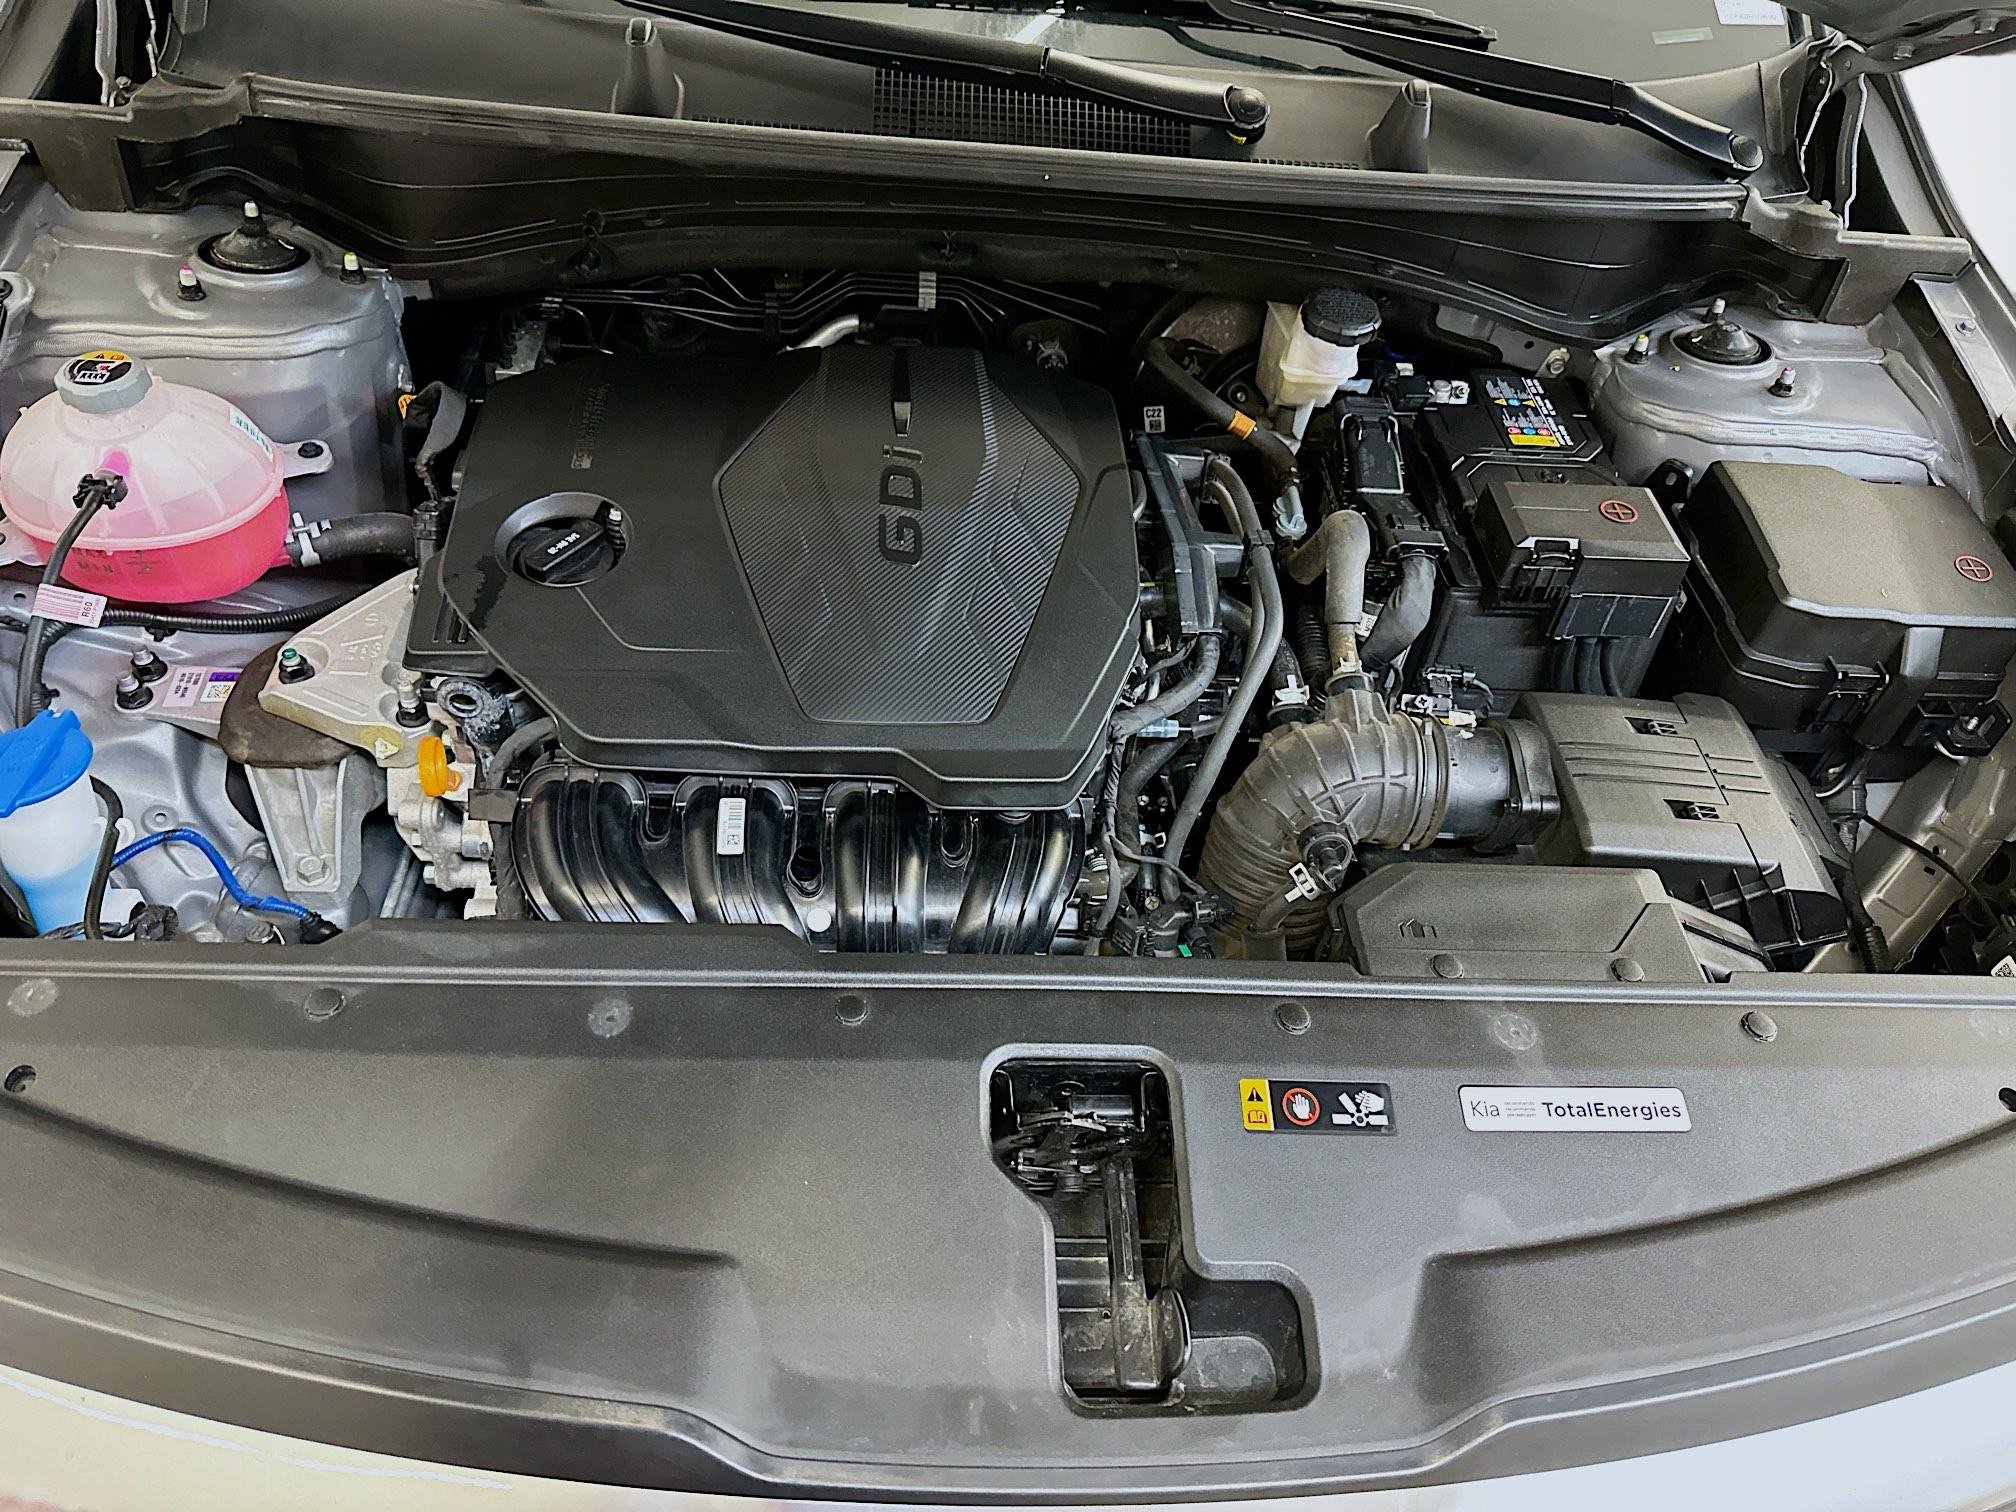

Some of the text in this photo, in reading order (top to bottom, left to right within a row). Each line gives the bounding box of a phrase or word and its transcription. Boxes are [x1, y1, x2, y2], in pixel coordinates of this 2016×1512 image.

[1145, 408, 1162, 418] C22
[879, 444, 923, 567] GDi
[1470, 1100, 1682, 1120] Kia TotalEnergies
